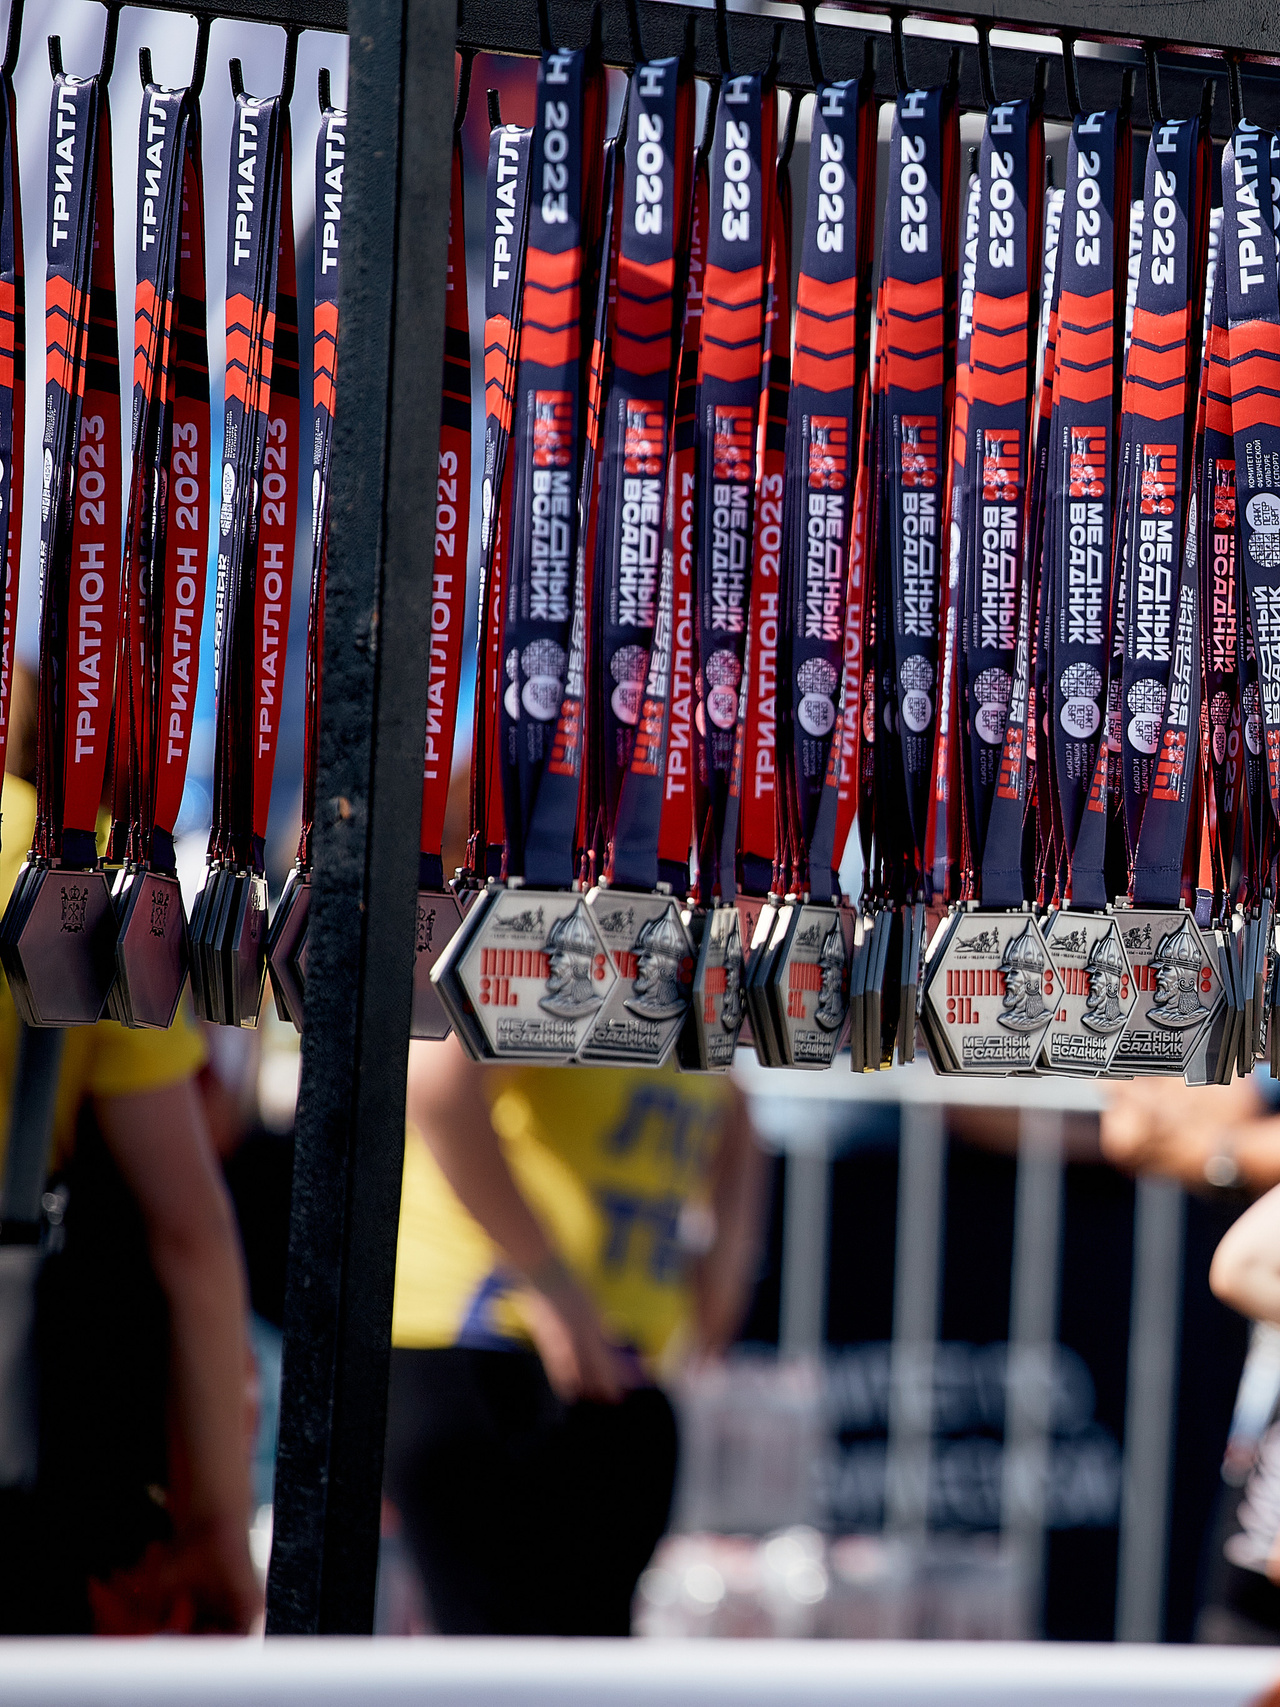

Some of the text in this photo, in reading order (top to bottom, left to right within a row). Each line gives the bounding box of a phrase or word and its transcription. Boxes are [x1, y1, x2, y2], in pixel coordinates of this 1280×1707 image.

[321, 109, 347, 275] ТРИАТЛ
[541, 101, 570, 225] 2023
[634, 113, 665, 236] 2023
[721, 120, 751, 242] 2023
[816, 132, 845, 254] 2023
[899, 135, 929, 255] 2023
[988, 151, 1015, 269] 2023
[1075, 151, 1101, 267] 2023
[1151, 170, 1177, 285] 2023
[75, 415, 106, 764] ТРИАТЛОН 2023
[166, 422, 199, 765] ТРИАТЛОН 2023
[258, 417, 287, 760] ТРИАТЛОН 2023
[424, 450, 459, 780] ТРИАТЛОН 2023
[530, 470, 551, 621] ВСАДНИК
[548, 470, 572, 623] МЕДНЫЙ
[619, 478, 642, 627] ВСАДНИК
[638, 479, 663, 628] МЕДНЫЙ
[712, 484, 731, 632] ВСАДНИК
[728, 485, 749, 634] МЕДНЫЙ
[805, 492, 827, 639] ВСАДНИК
[823, 494, 845, 642] МЕДНЫЙ
[902, 492, 919, 637] ВСАДНИК
[918, 492, 937, 638] МЕДНЫЙ
[981, 505, 1000, 650] ВСАДНИК
[998, 506, 1018, 650] МЕДНЫЙ
[1068, 502, 1086, 645] ВСАДНИК
[1086, 502, 1104, 645] МЕДНЫЙ
[1136, 519, 1157, 661] ВСАДНИК
[1153, 520, 1174, 662] МЕДНЫЙ
[1213, 533, 1229, 674] ВСАДНИК
[666, 592, 695, 801] ТРИАТЛОН
[755, 473, 783, 799] ТРИАТЛОН 2023
[1252, 585, 1273, 725] МЕДНЫЙ
[962, 1035, 1031, 1048] МЕДНЫЙ
[963, 1047, 1031, 1059] ВСАДНИК
[1051, 1047, 1107, 1059] ВСАДНИК
[1052, 1033, 1108, 1048] МЕДНЫЙ
[1119, 1042, 1183, 1054] САДНИК
[1122, 1030, 1184, 1043] ЕДНЫЙ
